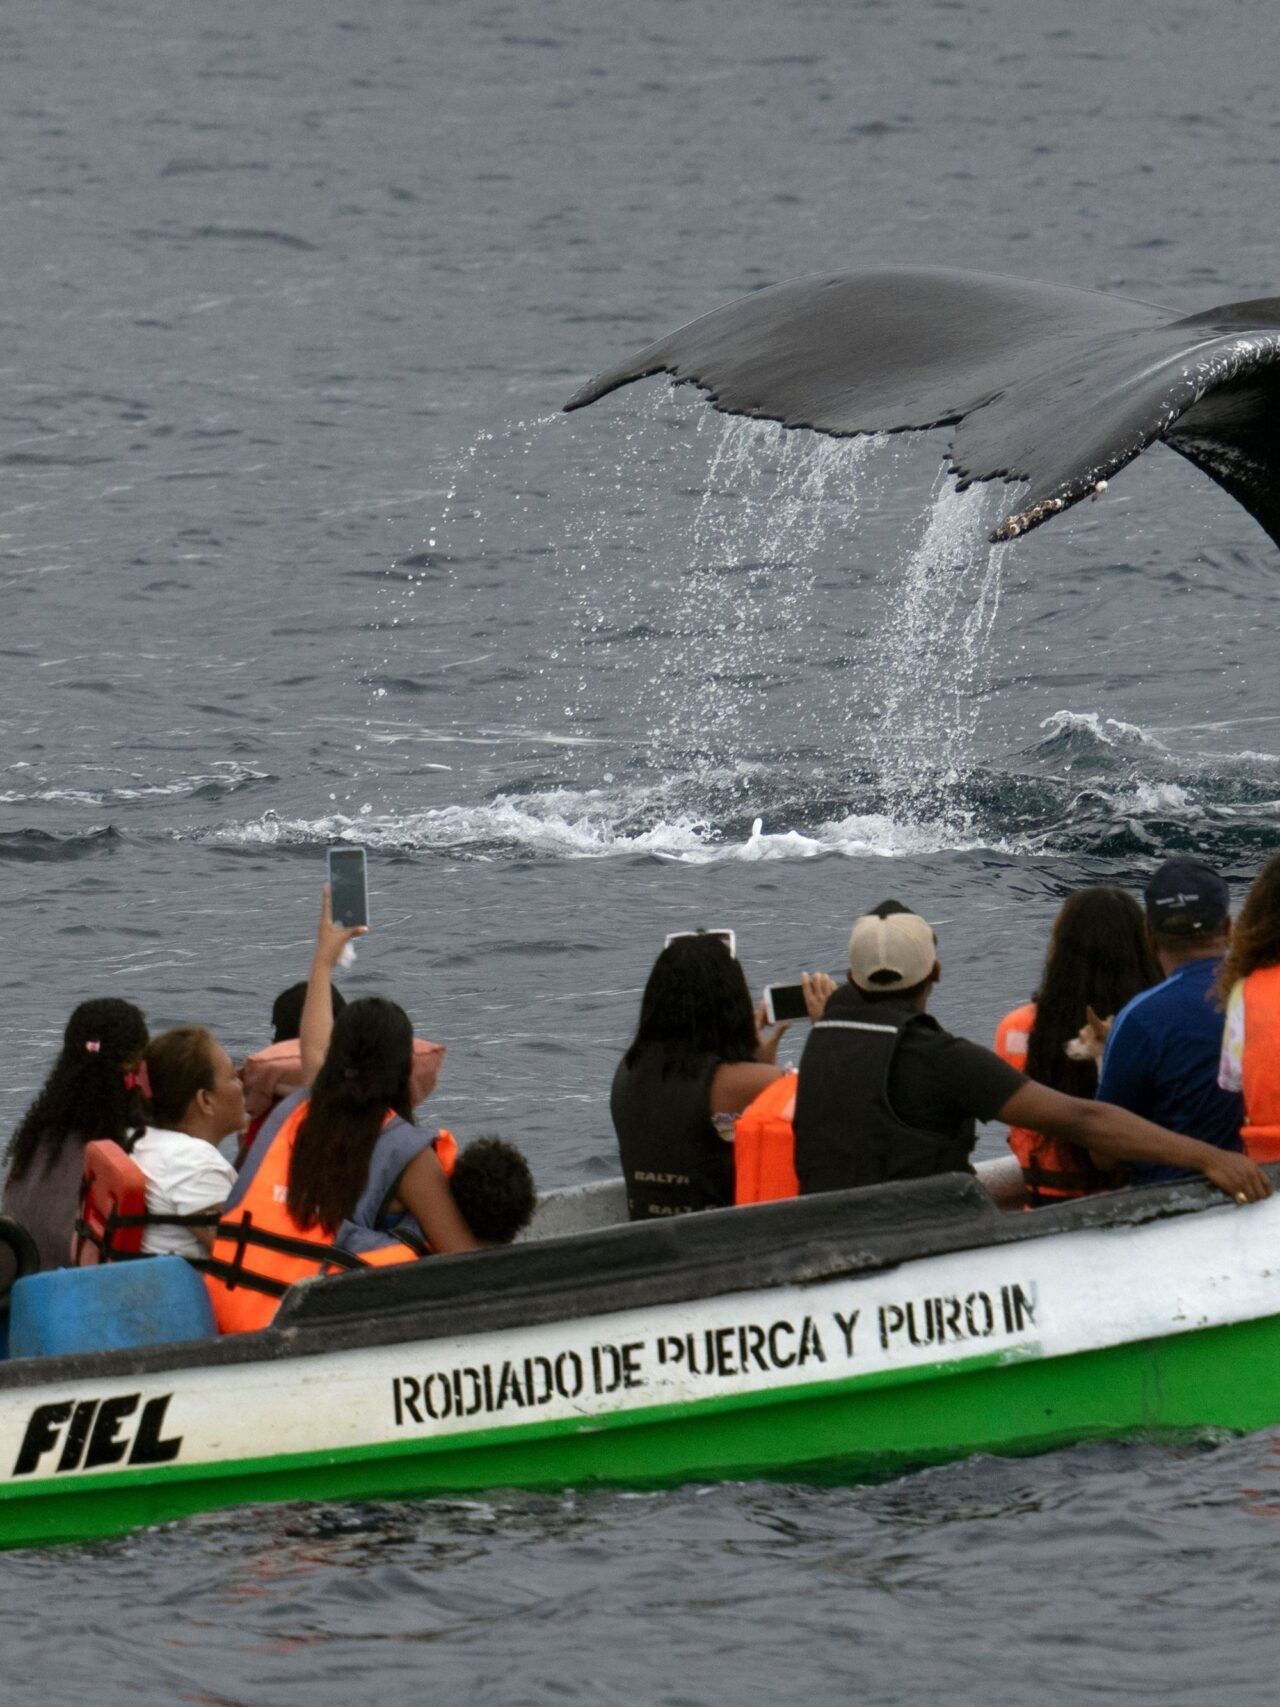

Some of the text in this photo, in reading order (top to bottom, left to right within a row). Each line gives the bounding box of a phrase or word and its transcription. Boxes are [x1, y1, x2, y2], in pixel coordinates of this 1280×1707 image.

[393, 1351, 582, 1425] RODIADO
[592, 1341, 646, 1394] DE
[657, 1316, 826, 1377] PUERCA
[833, 1310, 860, 1358] Y
[878, 1291, 993, 1350] PURO
[12, 1393, 183, 1477] FIEL
